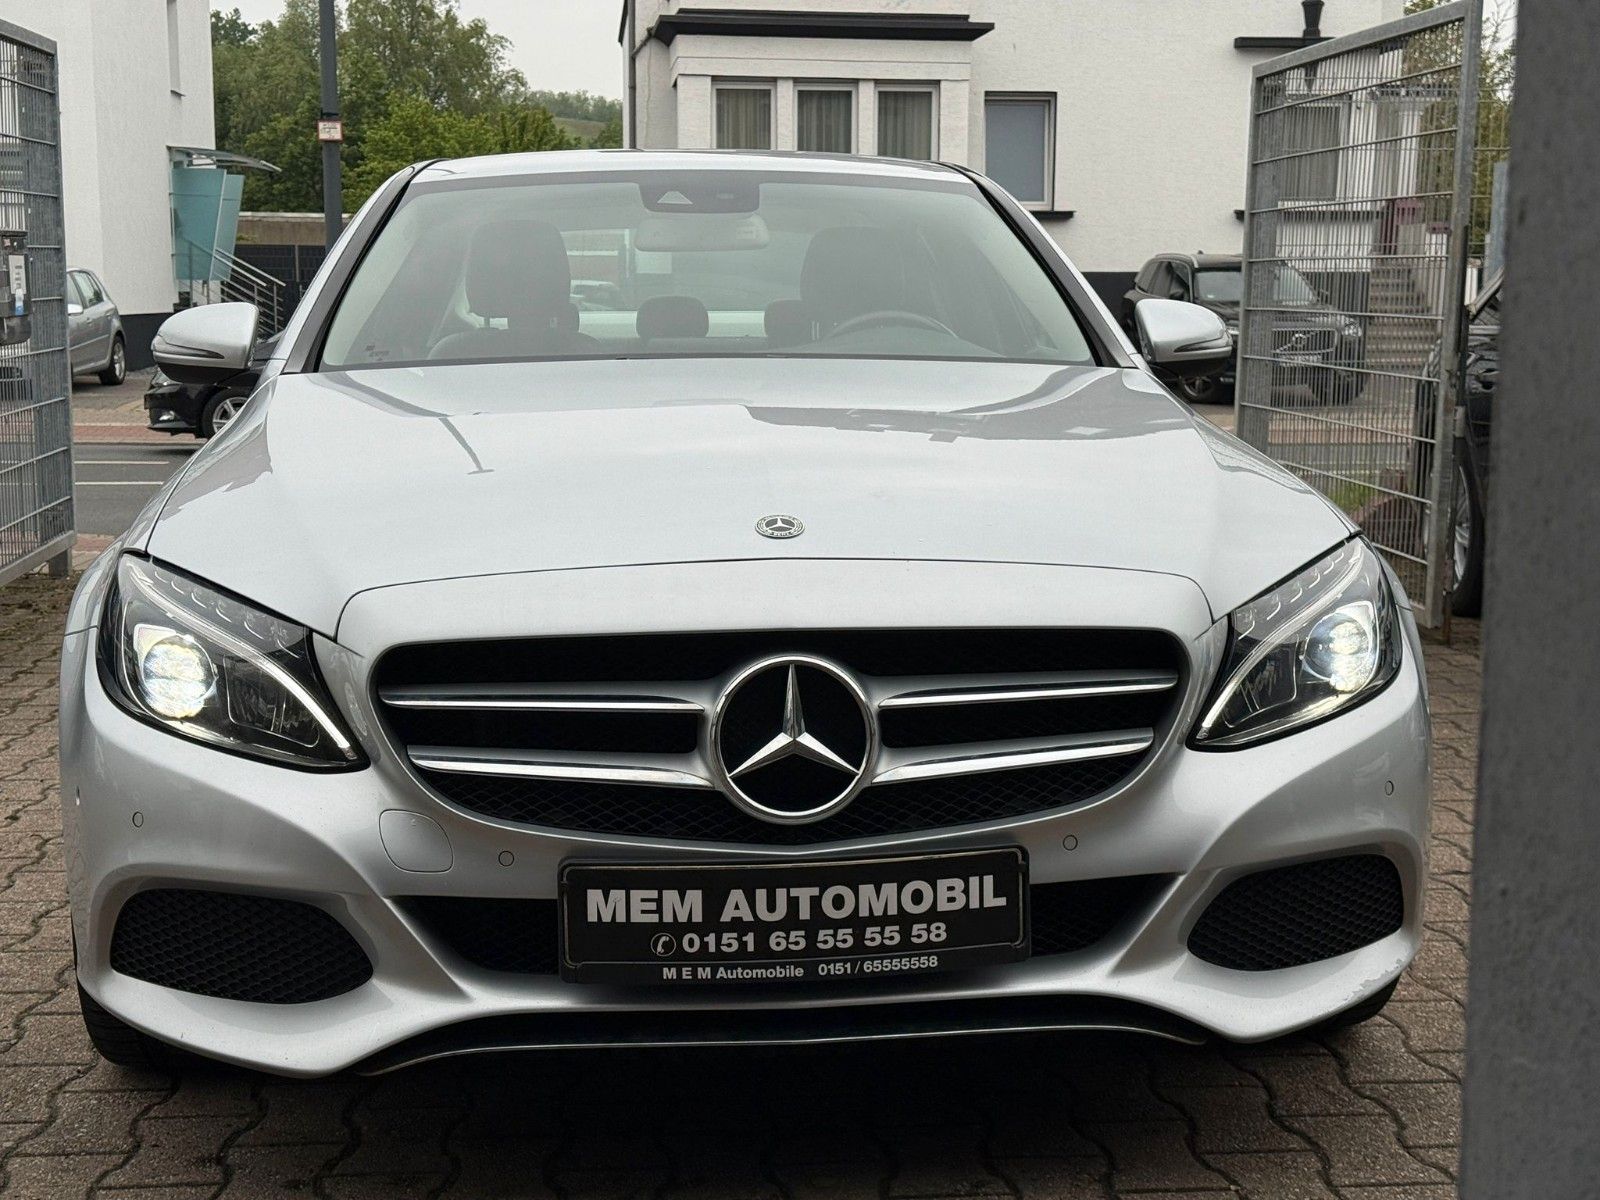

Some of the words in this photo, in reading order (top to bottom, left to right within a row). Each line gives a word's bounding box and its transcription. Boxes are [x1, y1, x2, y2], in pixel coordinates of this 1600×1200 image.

[586, 889, 703, 923] MEM
[719, 874, 1007, 922] AUTOMOBIL
[682, 932, 756, 953] 0151
[769, 930, 807, 952] 65
[816, 928, 854, 950] 55
[863, 925, 901, 947] 55
[910, 922, 947, 944] 58
[715, 965, 805, 979] Automobile
